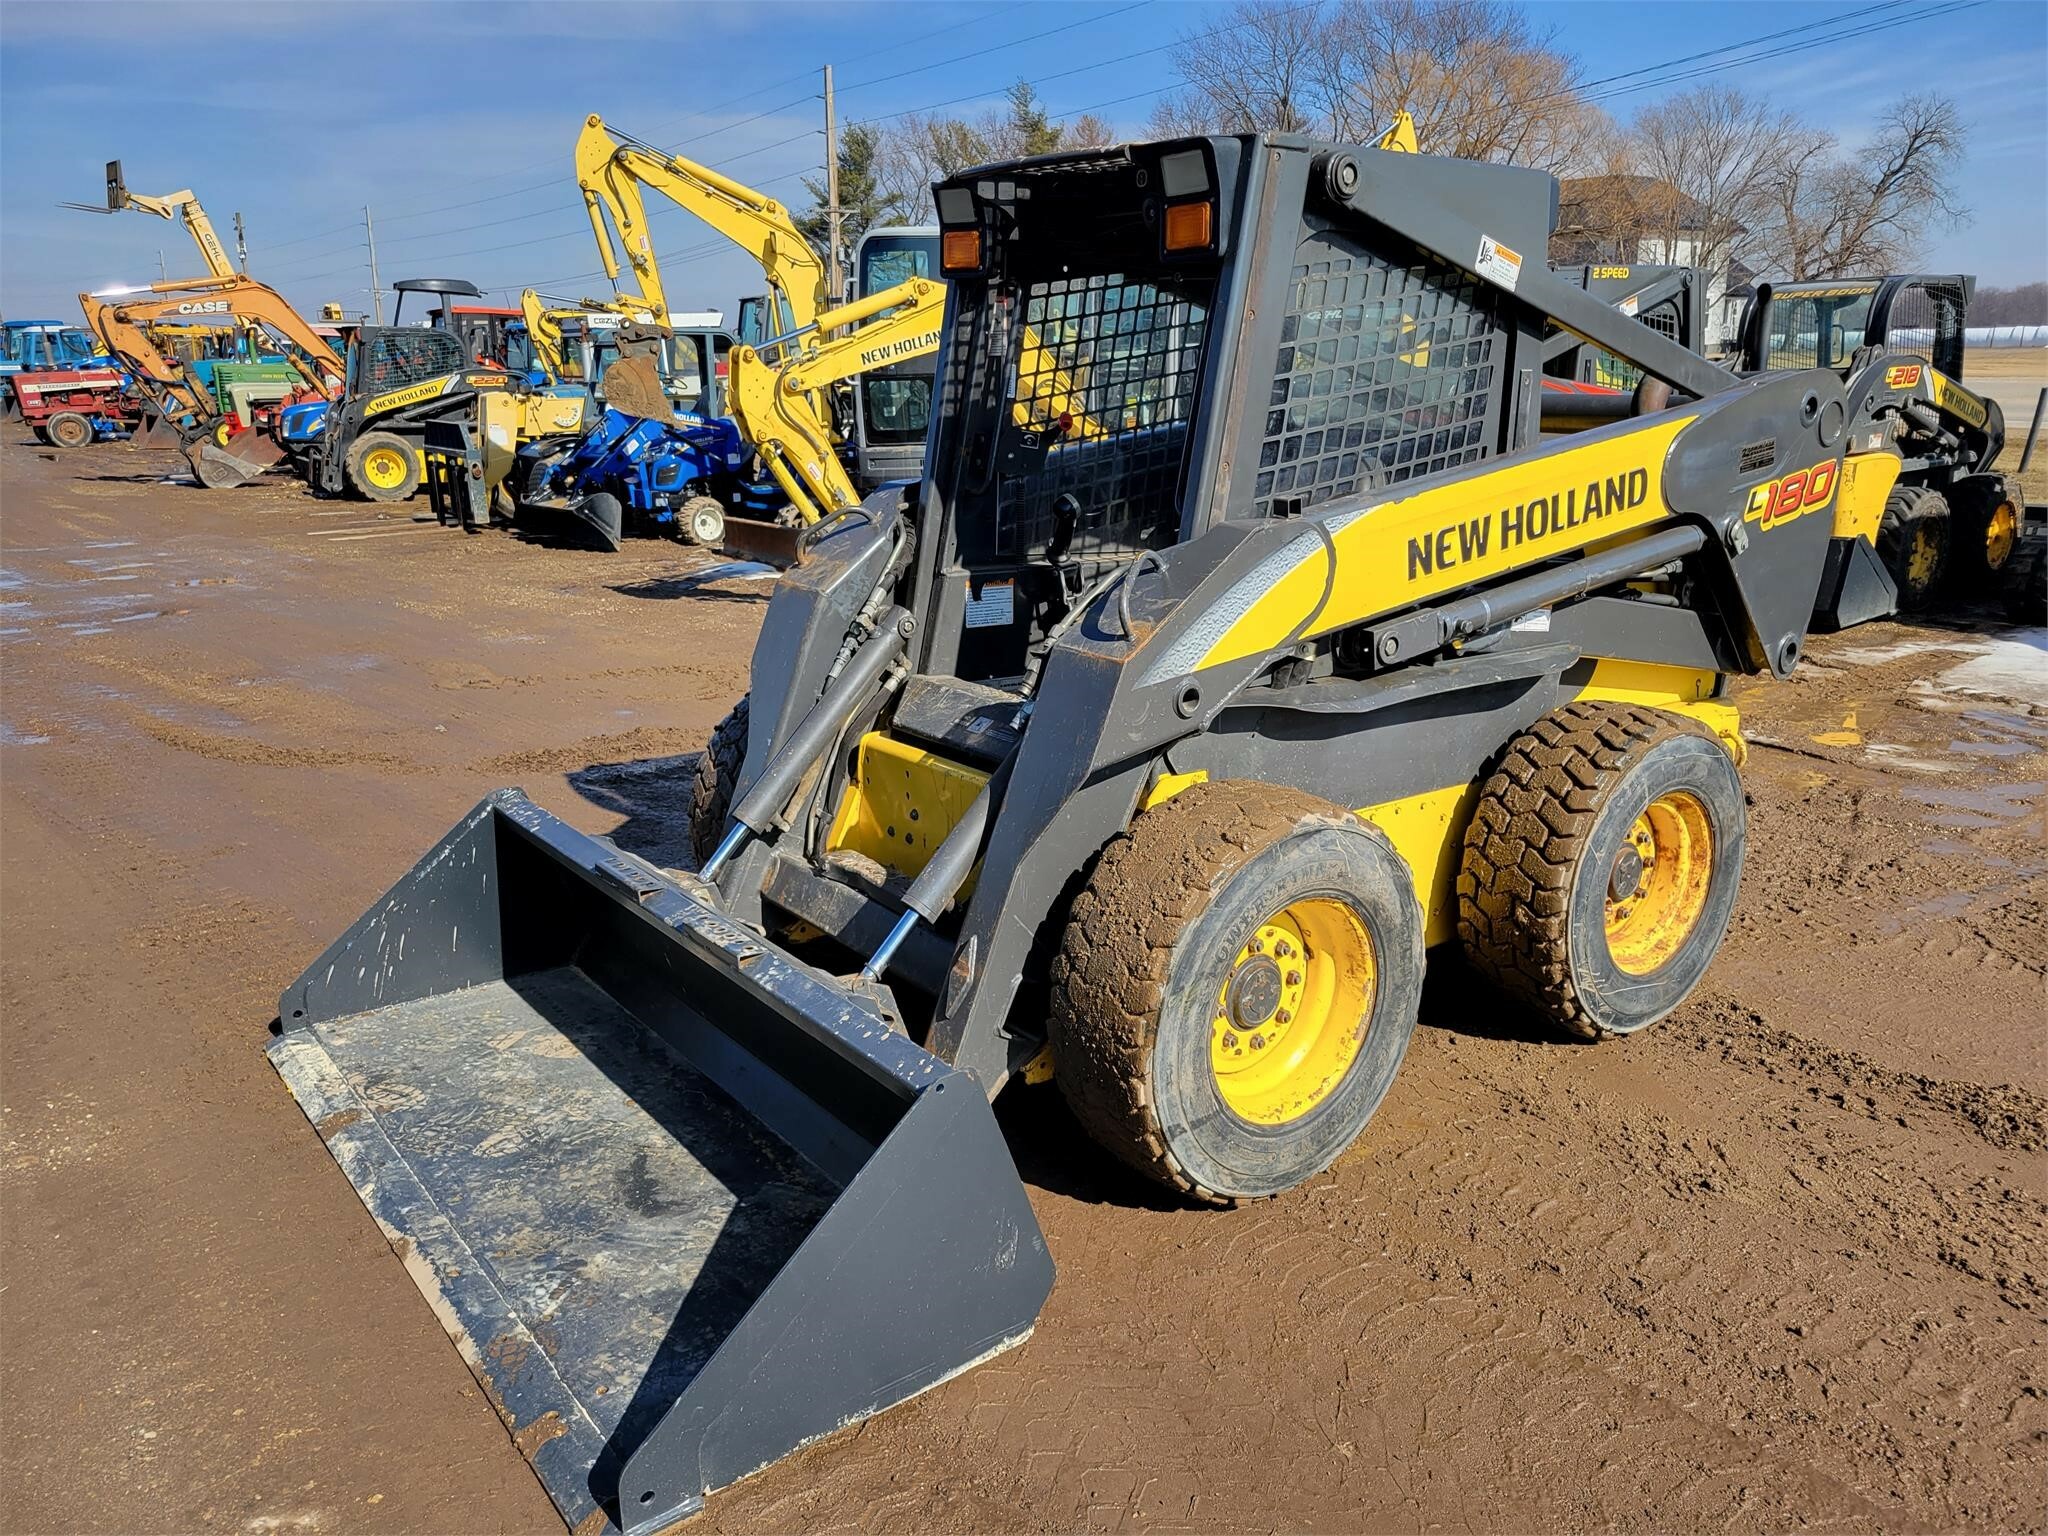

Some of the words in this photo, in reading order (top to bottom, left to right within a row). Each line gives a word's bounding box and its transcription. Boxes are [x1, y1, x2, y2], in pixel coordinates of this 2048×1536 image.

[204, 233, 221, 261] GEHL
[1593, 267, 1600, 279] 2
[1601, 267, 1630, 279] SPEED
[1773, 290, 1825, 300] SUPER
[1825, 287, 1875, 296] BOOM
[178, 301, 229, 314] CASE
[861, 345, 891, 365] NEW
[893, 330, 941, 355] HOLLAN
[467, 376, 507, 386] L220
[1887, 366, 1920, 387] L218
[376, 398, 396, 410] NEW
[399, 385, 438, 403] HOLLAND
[1939, 384, 1957, 404] NEW
[1955, 398, 1984, 423] HOLLAND
[1745, 459, 1838, 527] L180
[1407, 512, 1492, 582] NEW
[1500, 466, 1648, 551] HOLLAND
